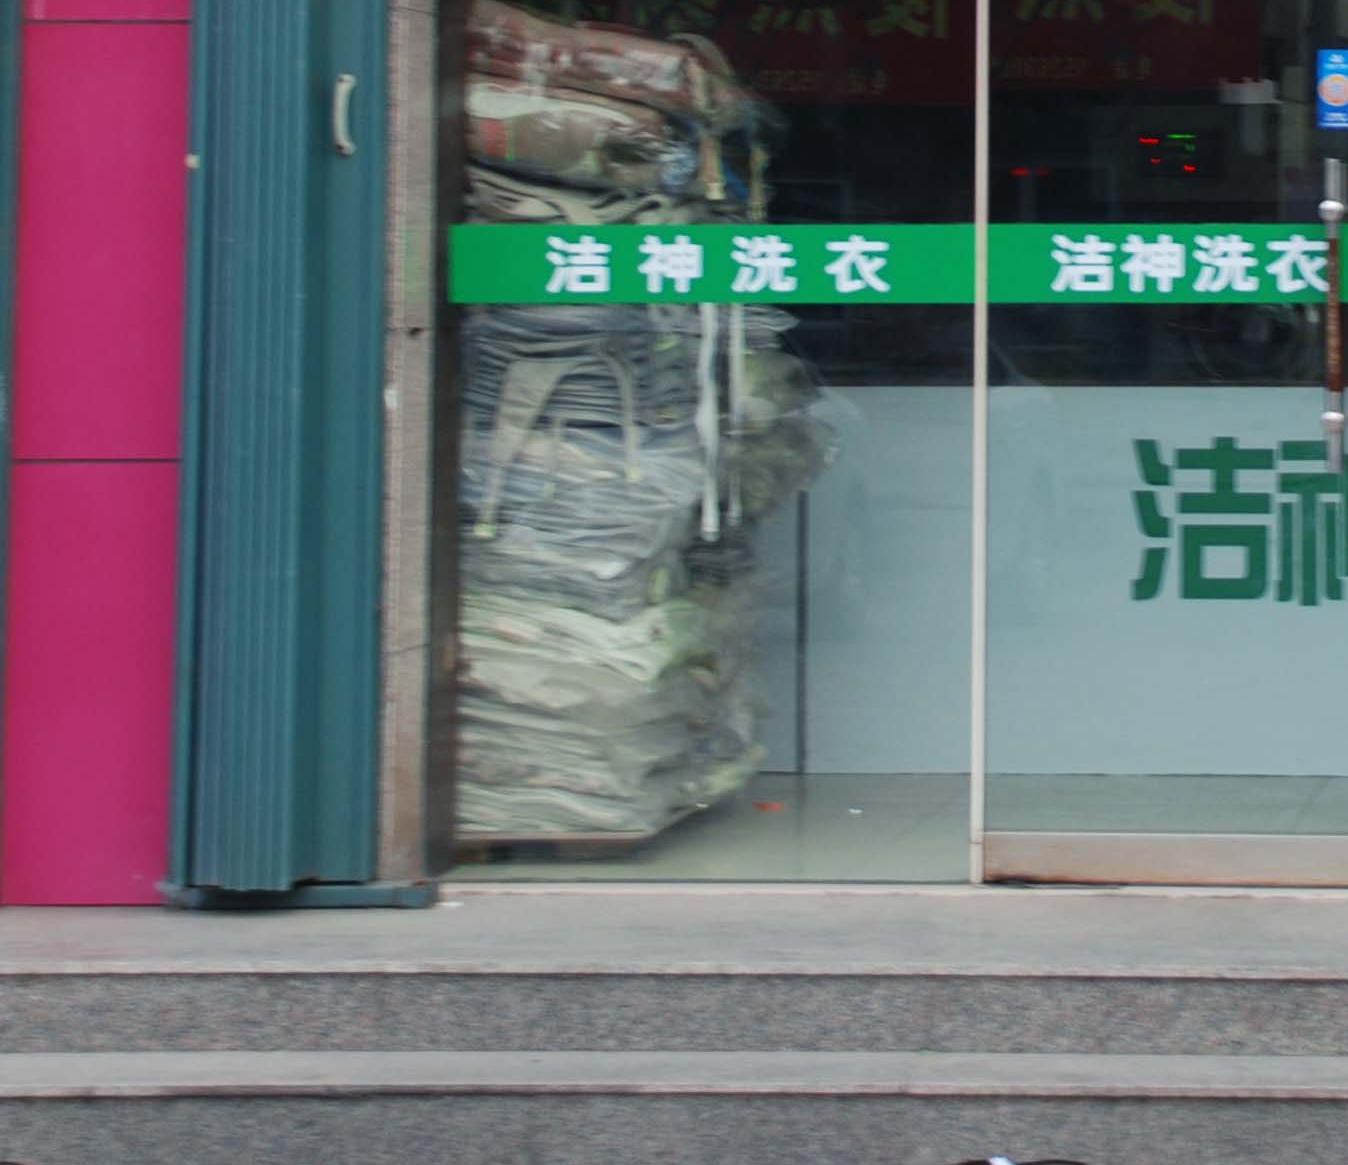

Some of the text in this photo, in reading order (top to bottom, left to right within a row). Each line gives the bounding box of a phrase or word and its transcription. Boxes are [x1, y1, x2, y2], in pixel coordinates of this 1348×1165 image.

[545, 233, 890, 294] 洁神洗衣
[1050, 233, 1331, 294] 洁神洗衣
